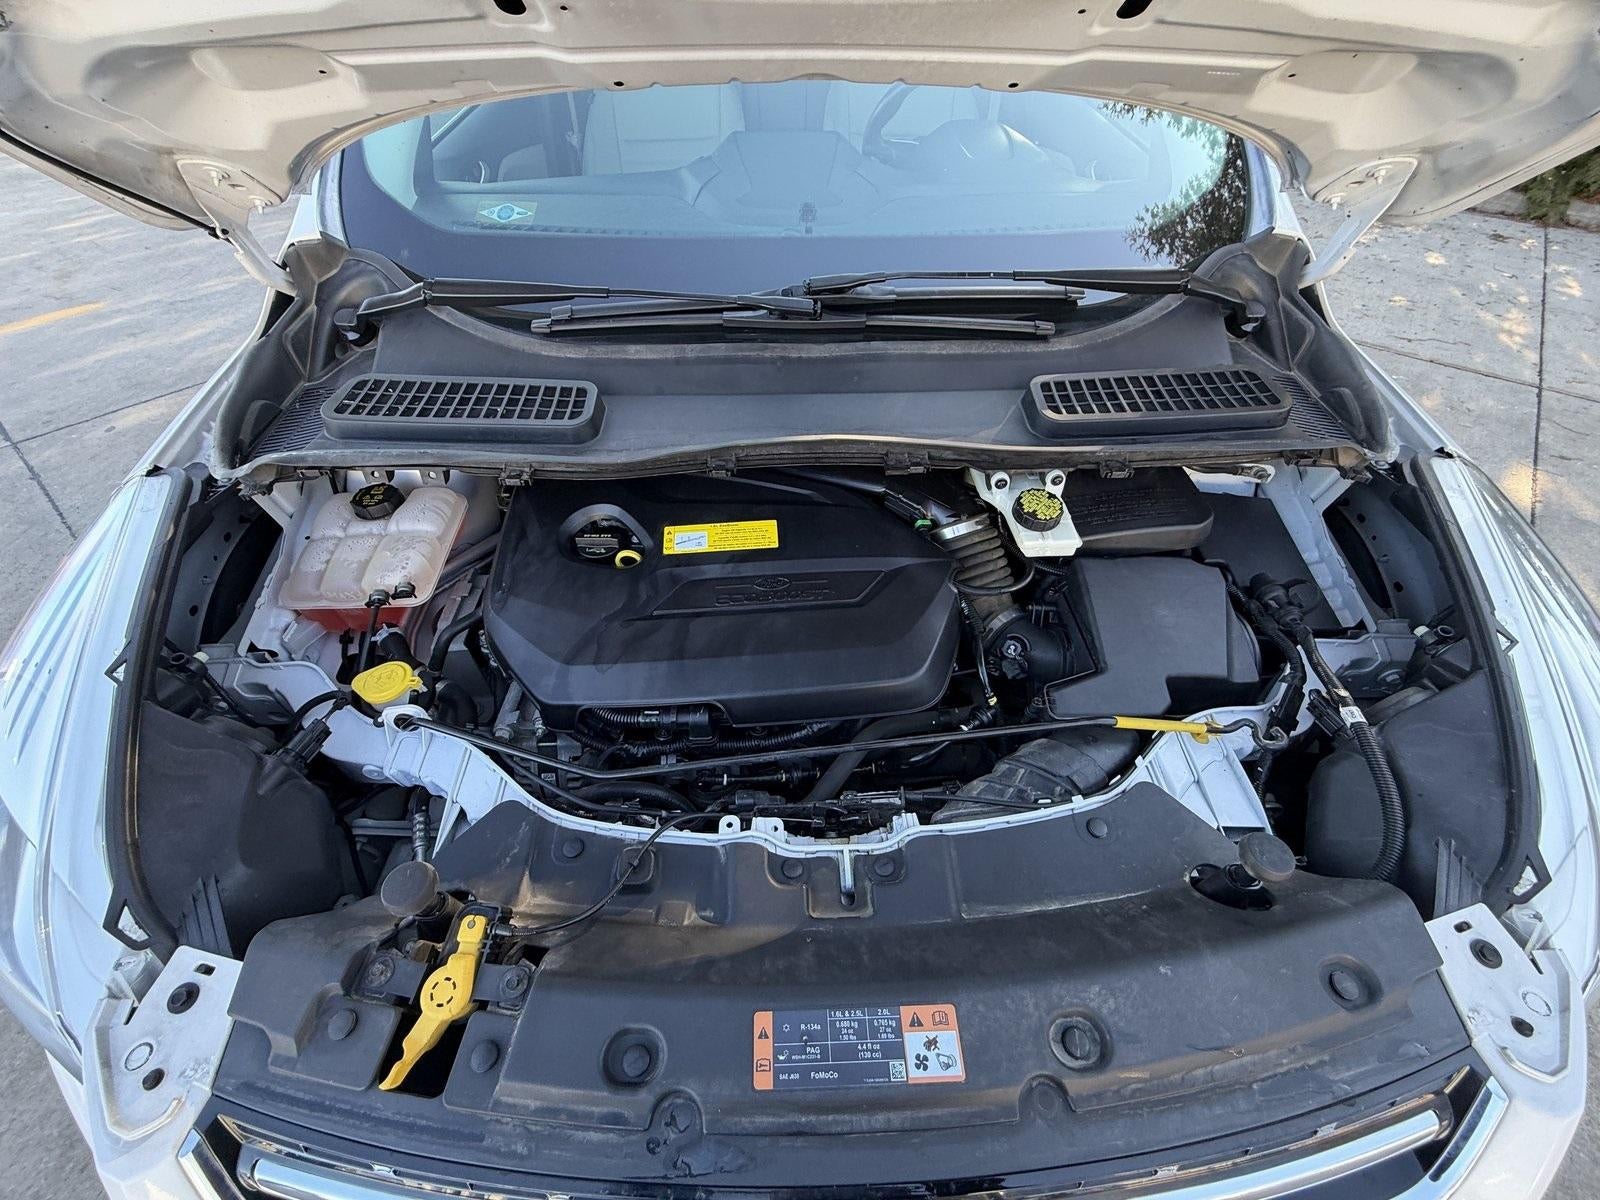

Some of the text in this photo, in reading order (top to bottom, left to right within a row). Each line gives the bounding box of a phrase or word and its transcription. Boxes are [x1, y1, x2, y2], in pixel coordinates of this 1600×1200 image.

[889, 1019, 896, 1027] kg
[806, 1046, 821, 1054] PAG
[858, 1051, 882, 1059] (130 cc)
[810, 1071, 839, 1079] FoMoCo
